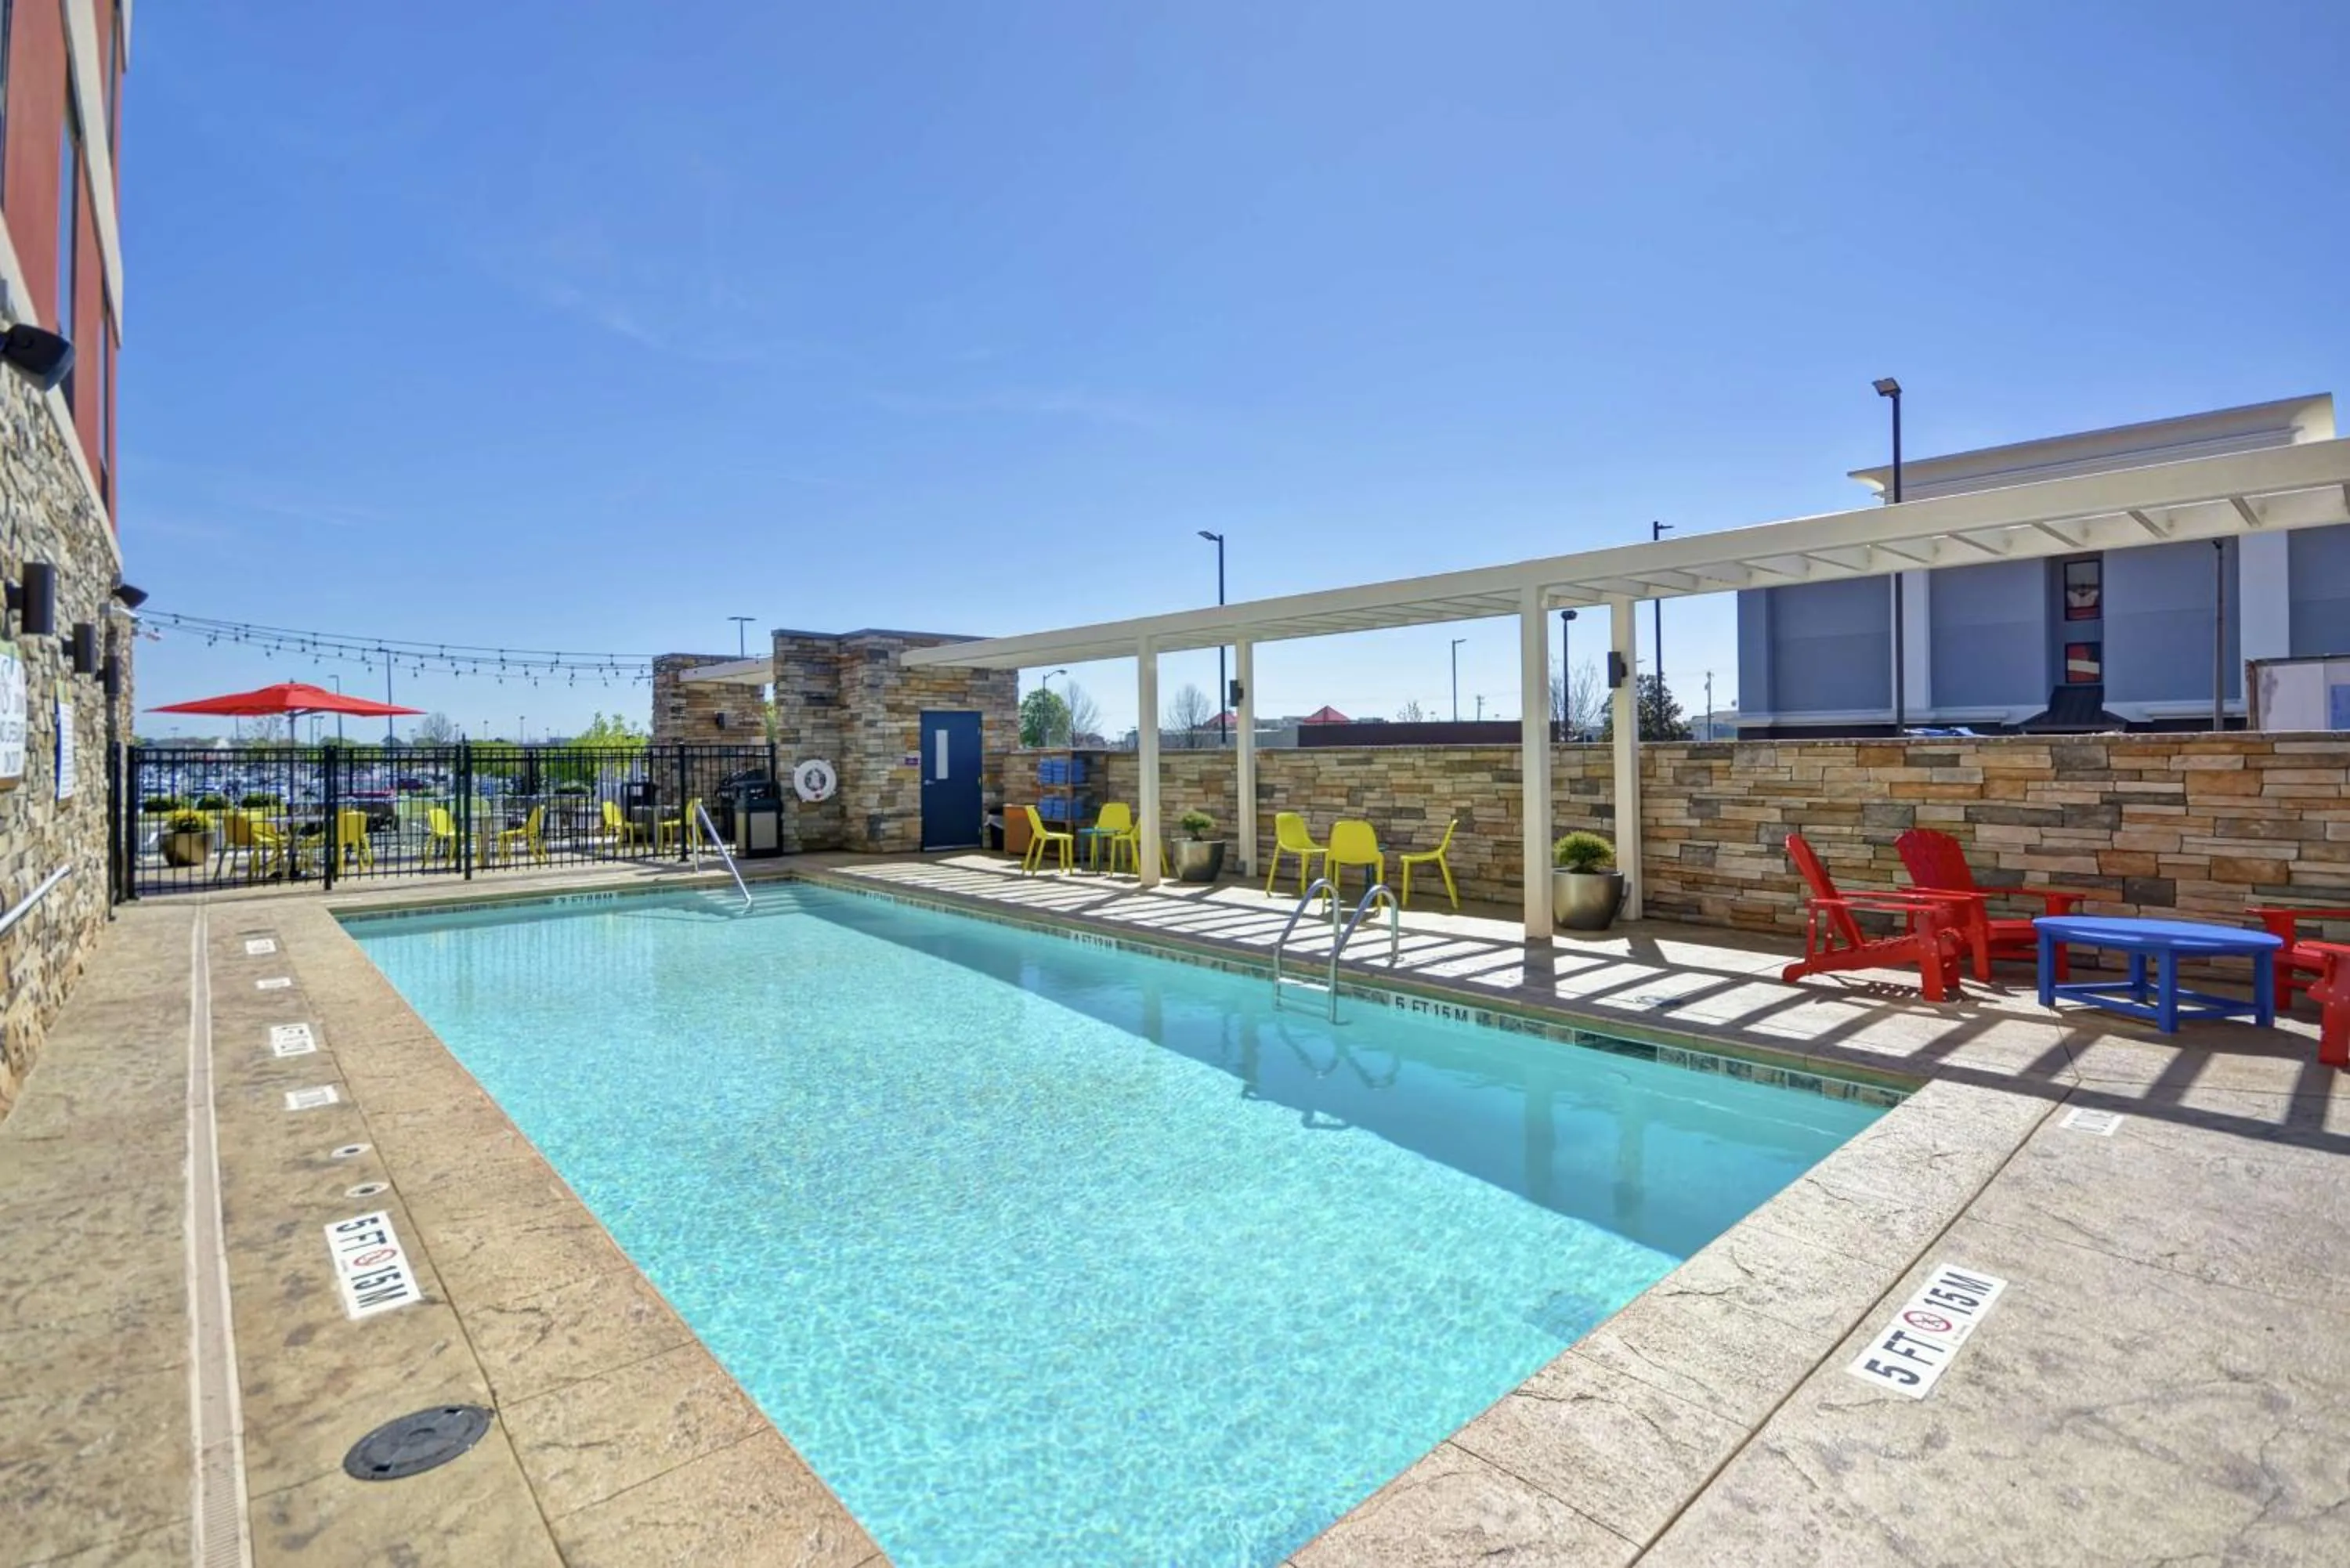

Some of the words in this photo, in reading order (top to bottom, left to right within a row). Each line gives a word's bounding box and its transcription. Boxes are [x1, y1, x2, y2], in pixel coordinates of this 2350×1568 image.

[1412, 999, 1430, 1014] FT
[335, 1216, 379, 1233] 5
[338, 1229, 388, 1252] FT
[1882, 1330, 1945, 1366] FT
[1863, 1358, 1921, 1386] 5
